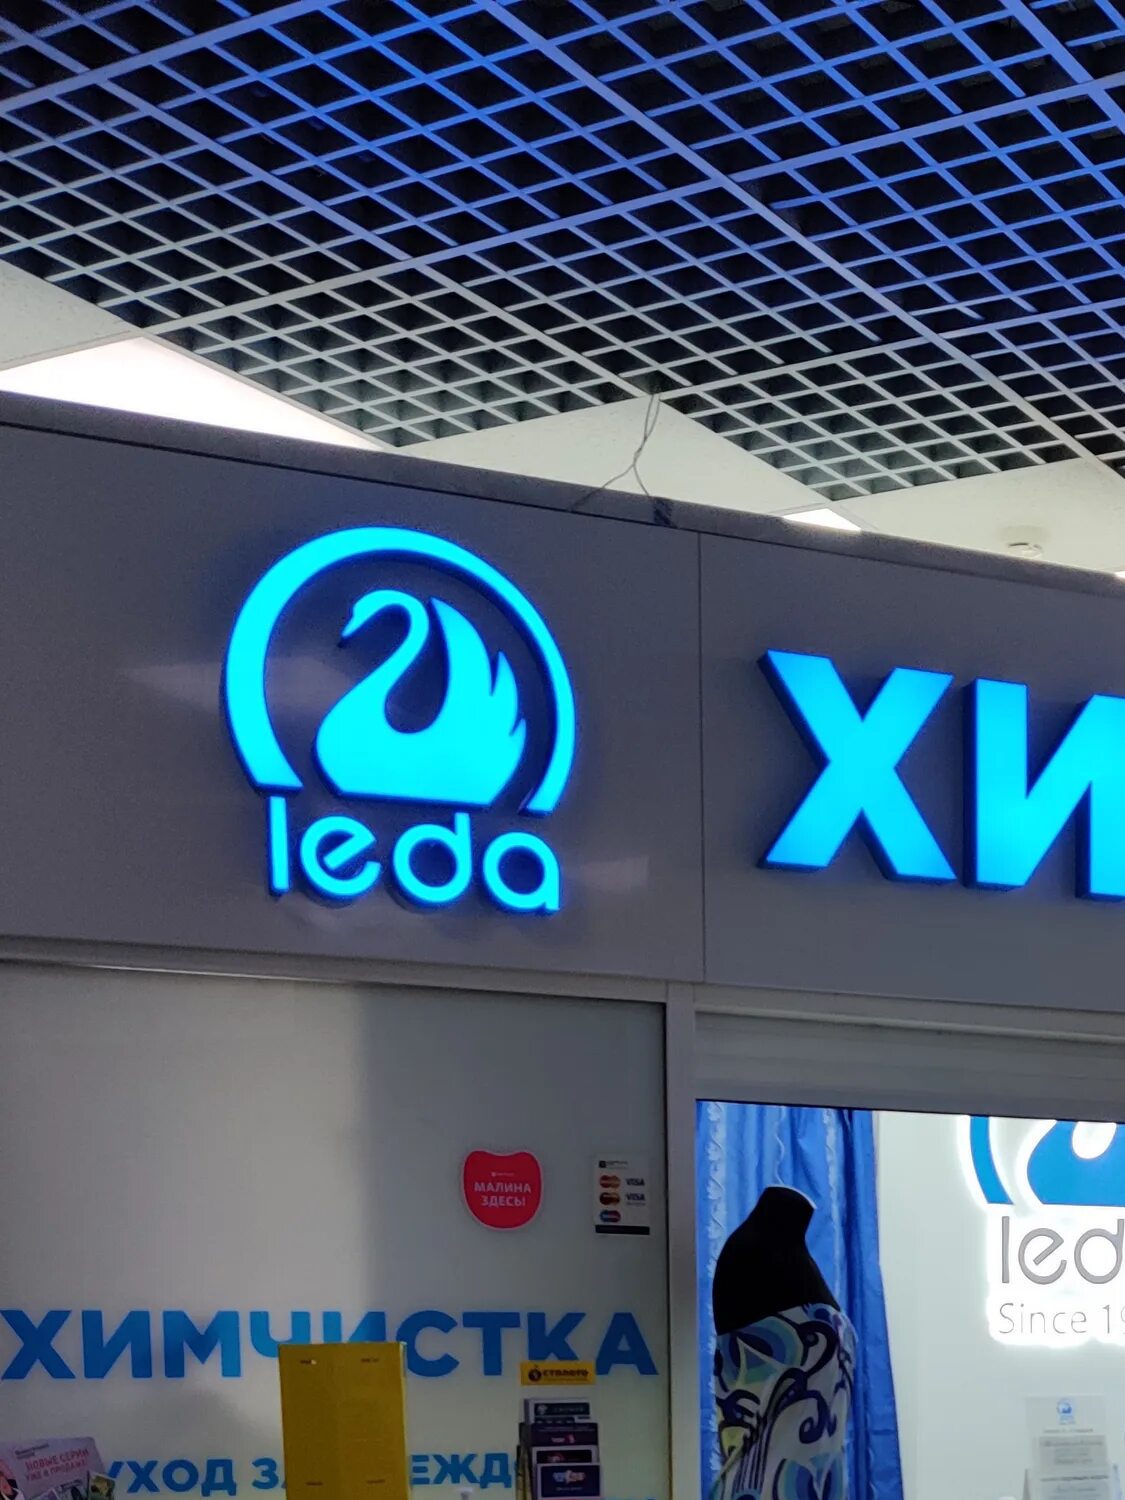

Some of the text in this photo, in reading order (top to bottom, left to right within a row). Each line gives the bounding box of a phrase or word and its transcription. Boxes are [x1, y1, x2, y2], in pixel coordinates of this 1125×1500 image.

[268, 795, 561, 912] leda
[473, 1181, 532, 1194] МАЛИНА
[625, 1178, 645, 1186] VISA
[625, 1193, 646, 1201] VISA
[999, 1302, 1088, 1334] Since
